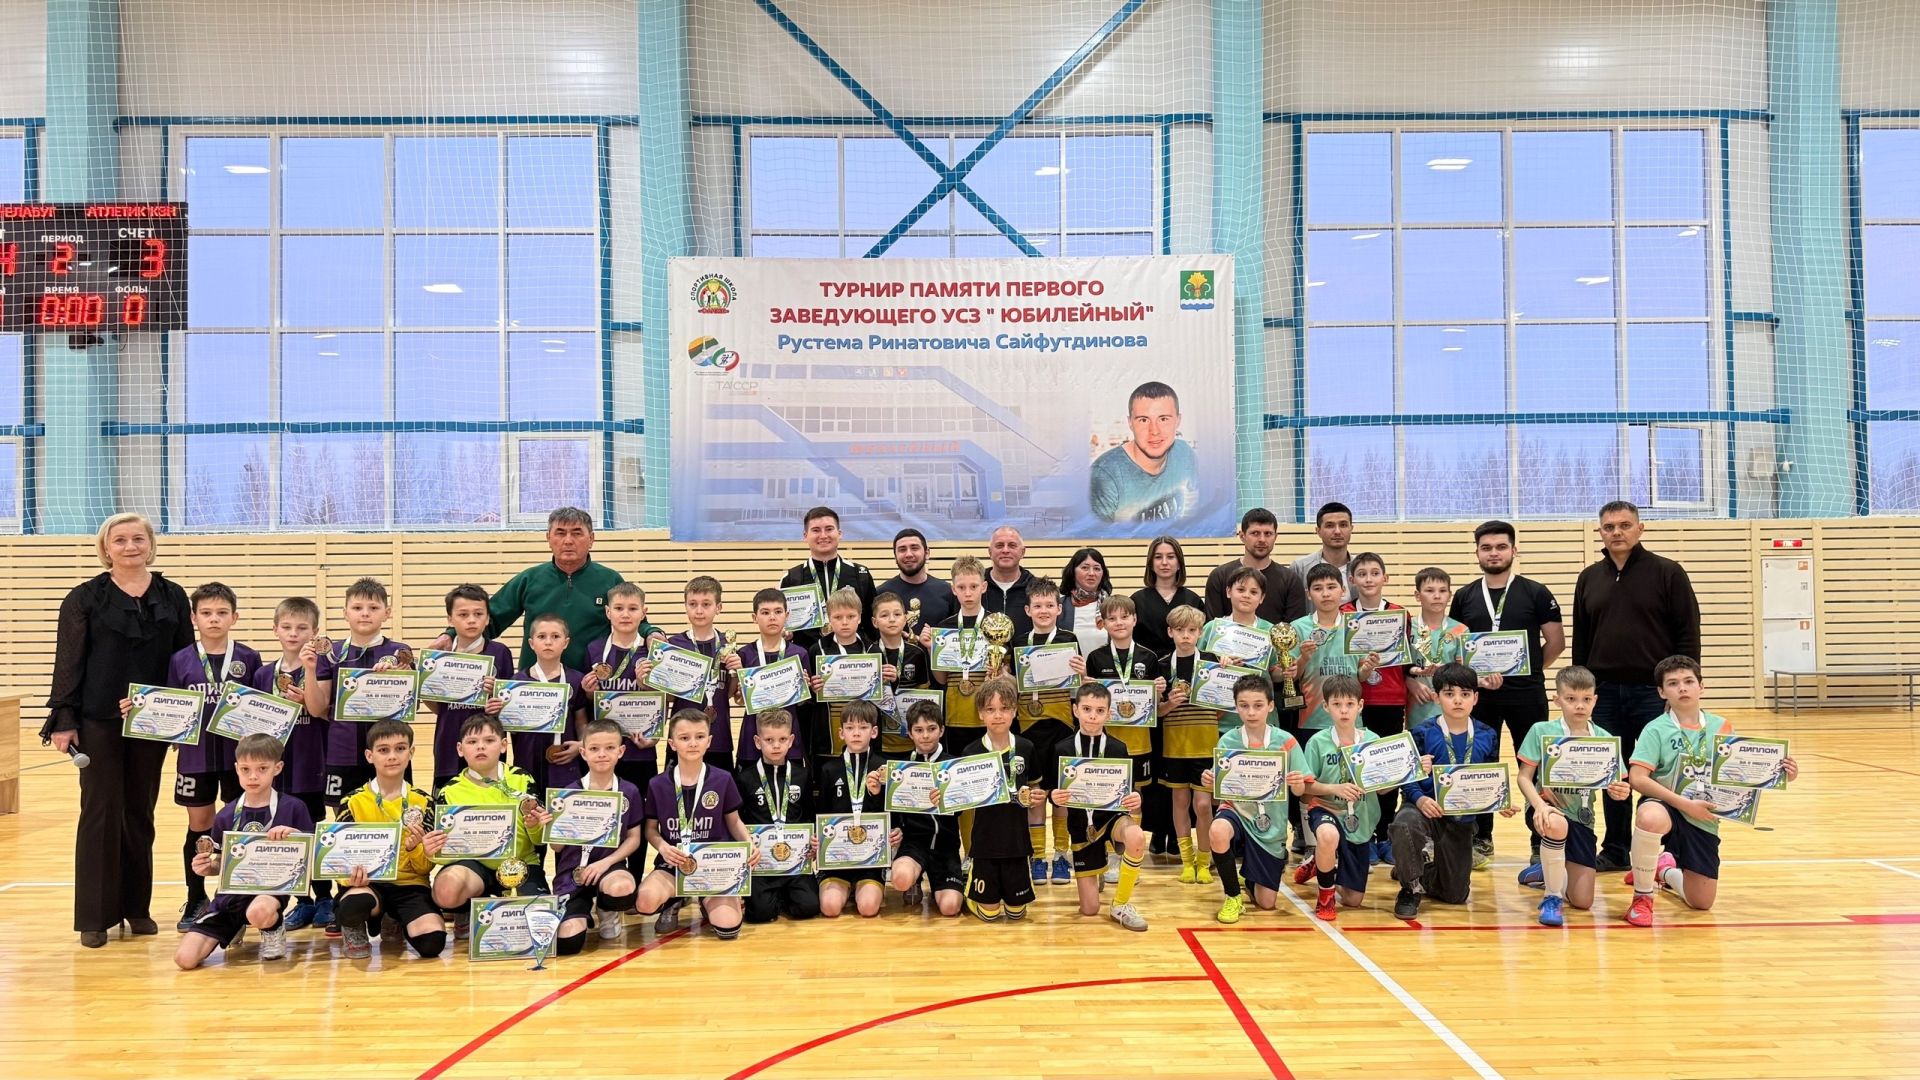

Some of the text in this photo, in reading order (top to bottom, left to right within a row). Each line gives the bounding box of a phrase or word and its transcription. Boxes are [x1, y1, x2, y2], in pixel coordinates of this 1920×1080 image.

[87, 206, 147, 217] АТЛЕТИК
[41, 235, 84, 244] ПЕРИОД
[118, 228, 155, 239] СЧЕТ
[53, 244, 75, 275] 2
[141, 239, 165, 278] 3
[44, 286, 80, 294] ВРЕМЯ
[115, 285, 148, 293] ФОЛЫ
[691, 273, 737, 301] СПОРТИВНАЯ ШКОЛА
[819, 280, 1105, 298] ТУРНИР ПАМЯТИ ПЕРВОГО
[41, 295, 103, 325] 0:00
[124, 295, 145, 325] 0
[770, 307, 936, 326] ЗАВЕДУЮЩЕГО
[942, 308, 981, 324] УСЗ
[778, 333, 1148, 354] Рустема Ринатовича Сайфутдинова
[444, 662, 482, 670] ДИПЛОМ
[670, 655, 702, 668] ДИПЛОМ
[839, 662, 873, 670] ДИПЛОМ
[760, 666, 793, 680] ДИПЛОМ
[153, 697, 193, 707] ДИПЛОМ
[249, 699, 288, 715] ДИПЛОМ
[1369, 742, 1405, 756] ДИПЛОМ
[1671, 738, 1683, 750] 24
[1739, 746, 1778, 754] ДИПЛОМ
[957, 763, 993, 774] ДИПЛОМ
[1142, 760, 1150, 777] 11
[1460, 772, 1500, 780] ДИПЛОМ
[177, 773, 196, 797] 22
[1553, 787, 1580, 795] ATHLE
[573, 800, 611, 808] ДИПЛОМ
[757, 795, 764, 806] 3
[666, 816, 713, 831] ОЛМП
[669, 830, 710, 840] МАДЫШ
[702, 852, 741, 860] ДИПЛОМ
[973, 878, 985, 894] 10
